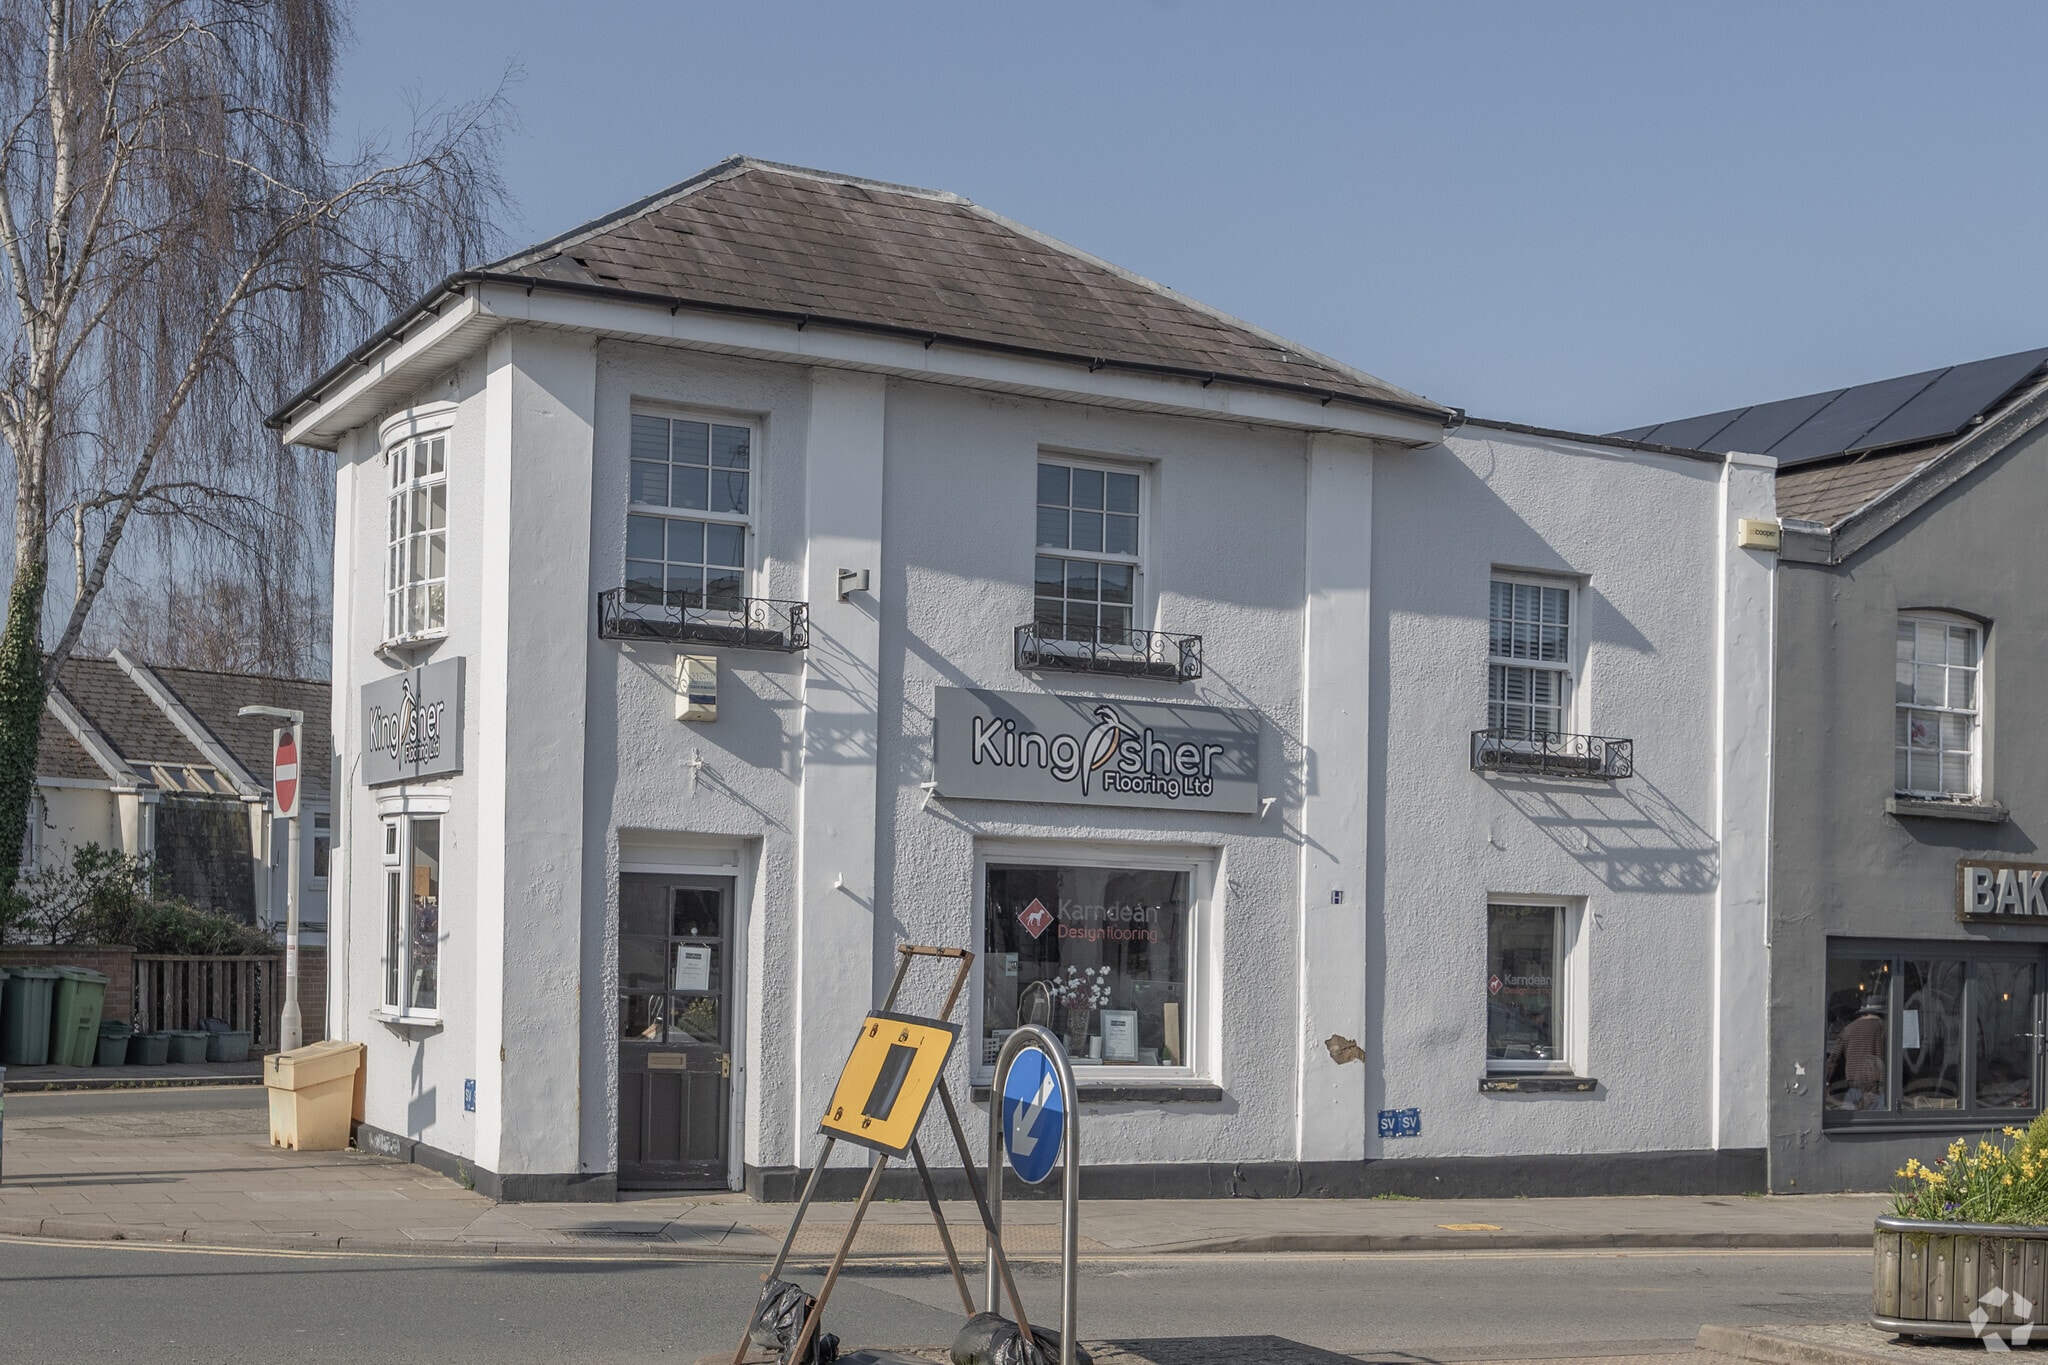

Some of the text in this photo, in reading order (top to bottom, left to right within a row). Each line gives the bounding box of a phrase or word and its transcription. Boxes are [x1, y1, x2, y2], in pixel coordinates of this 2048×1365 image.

[429, 737, 440, 760] Ltd
[1103, 772, 1213, 799] Flooring Ltd
[1057, 898, 1158, 922] Karndean
[1504, 974, 1552, 986] Karndean
[1381, 1117, 1395, 1130] SV
[1402, 1116, 1417, 1128] SV
